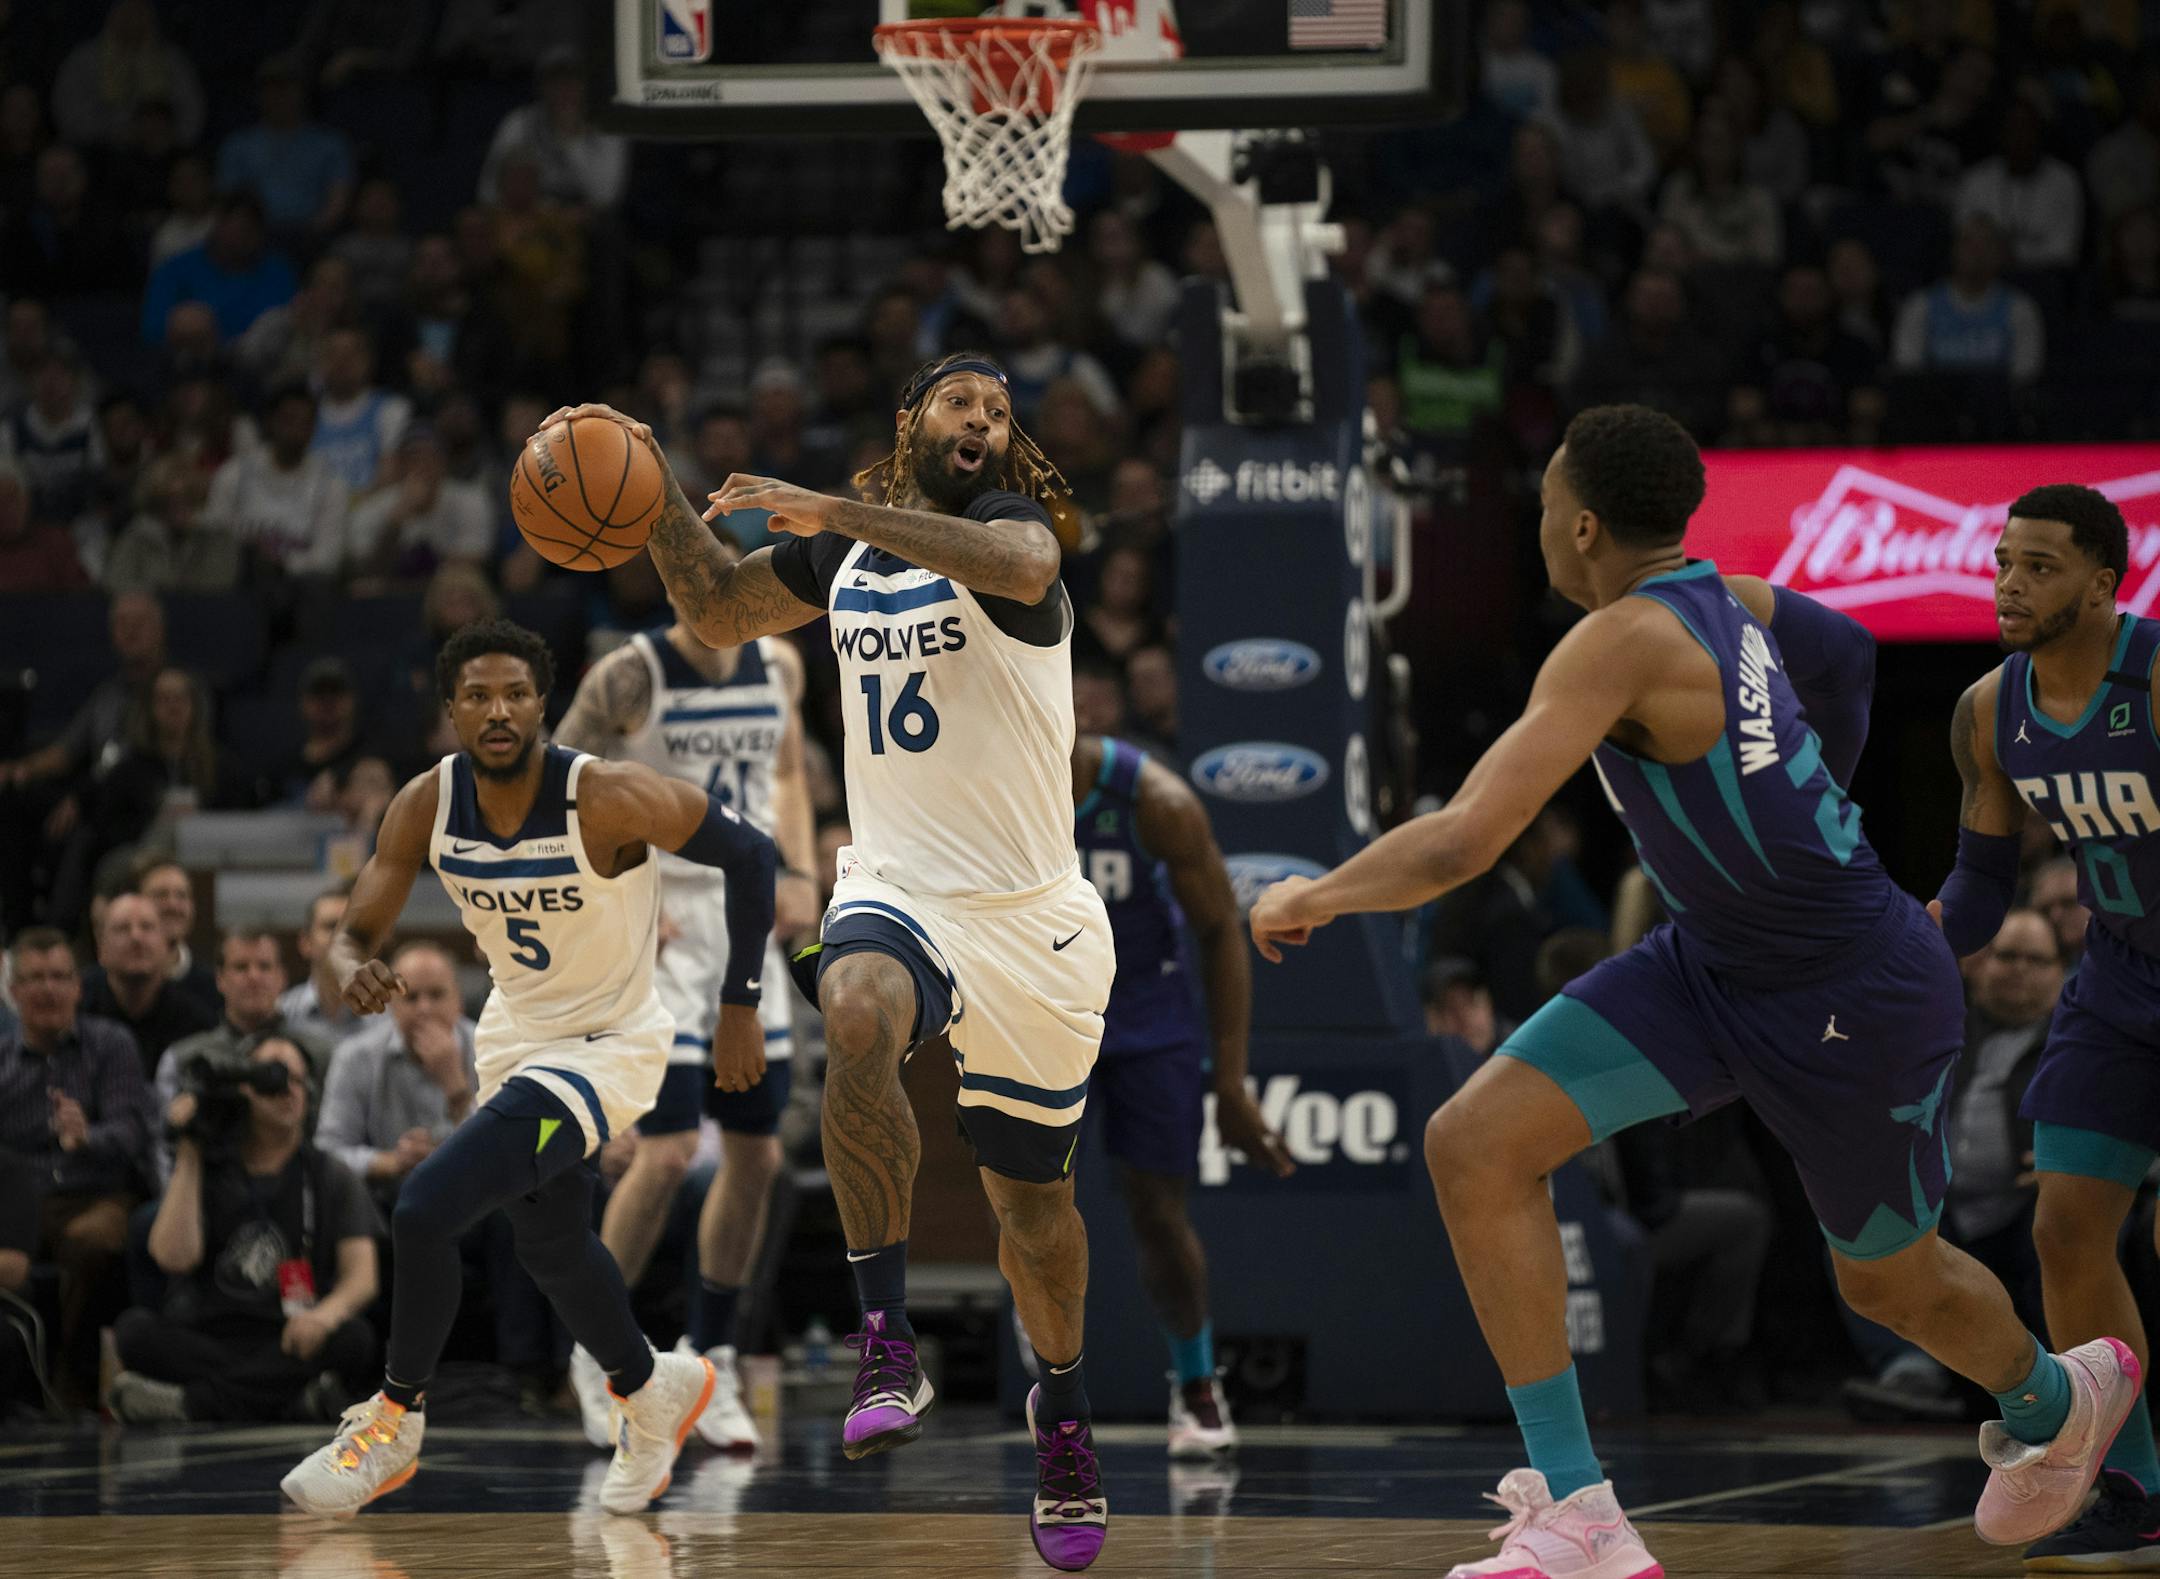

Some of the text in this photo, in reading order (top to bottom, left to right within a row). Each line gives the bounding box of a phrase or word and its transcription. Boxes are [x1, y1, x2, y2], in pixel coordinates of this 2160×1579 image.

[1237, 460, 1341, 502] fitbit
[836, 616, 967, 662] WOLVES
[1221, 646, 1301, 687] Ford
[860, 671, 940, 755] 16
[664, 728, 776, 757] WOLVES
[1213, 751, 1305, 795] Ford
[537, 842, 565, 854] fitbit
[505, 917, 551, 971] 5
